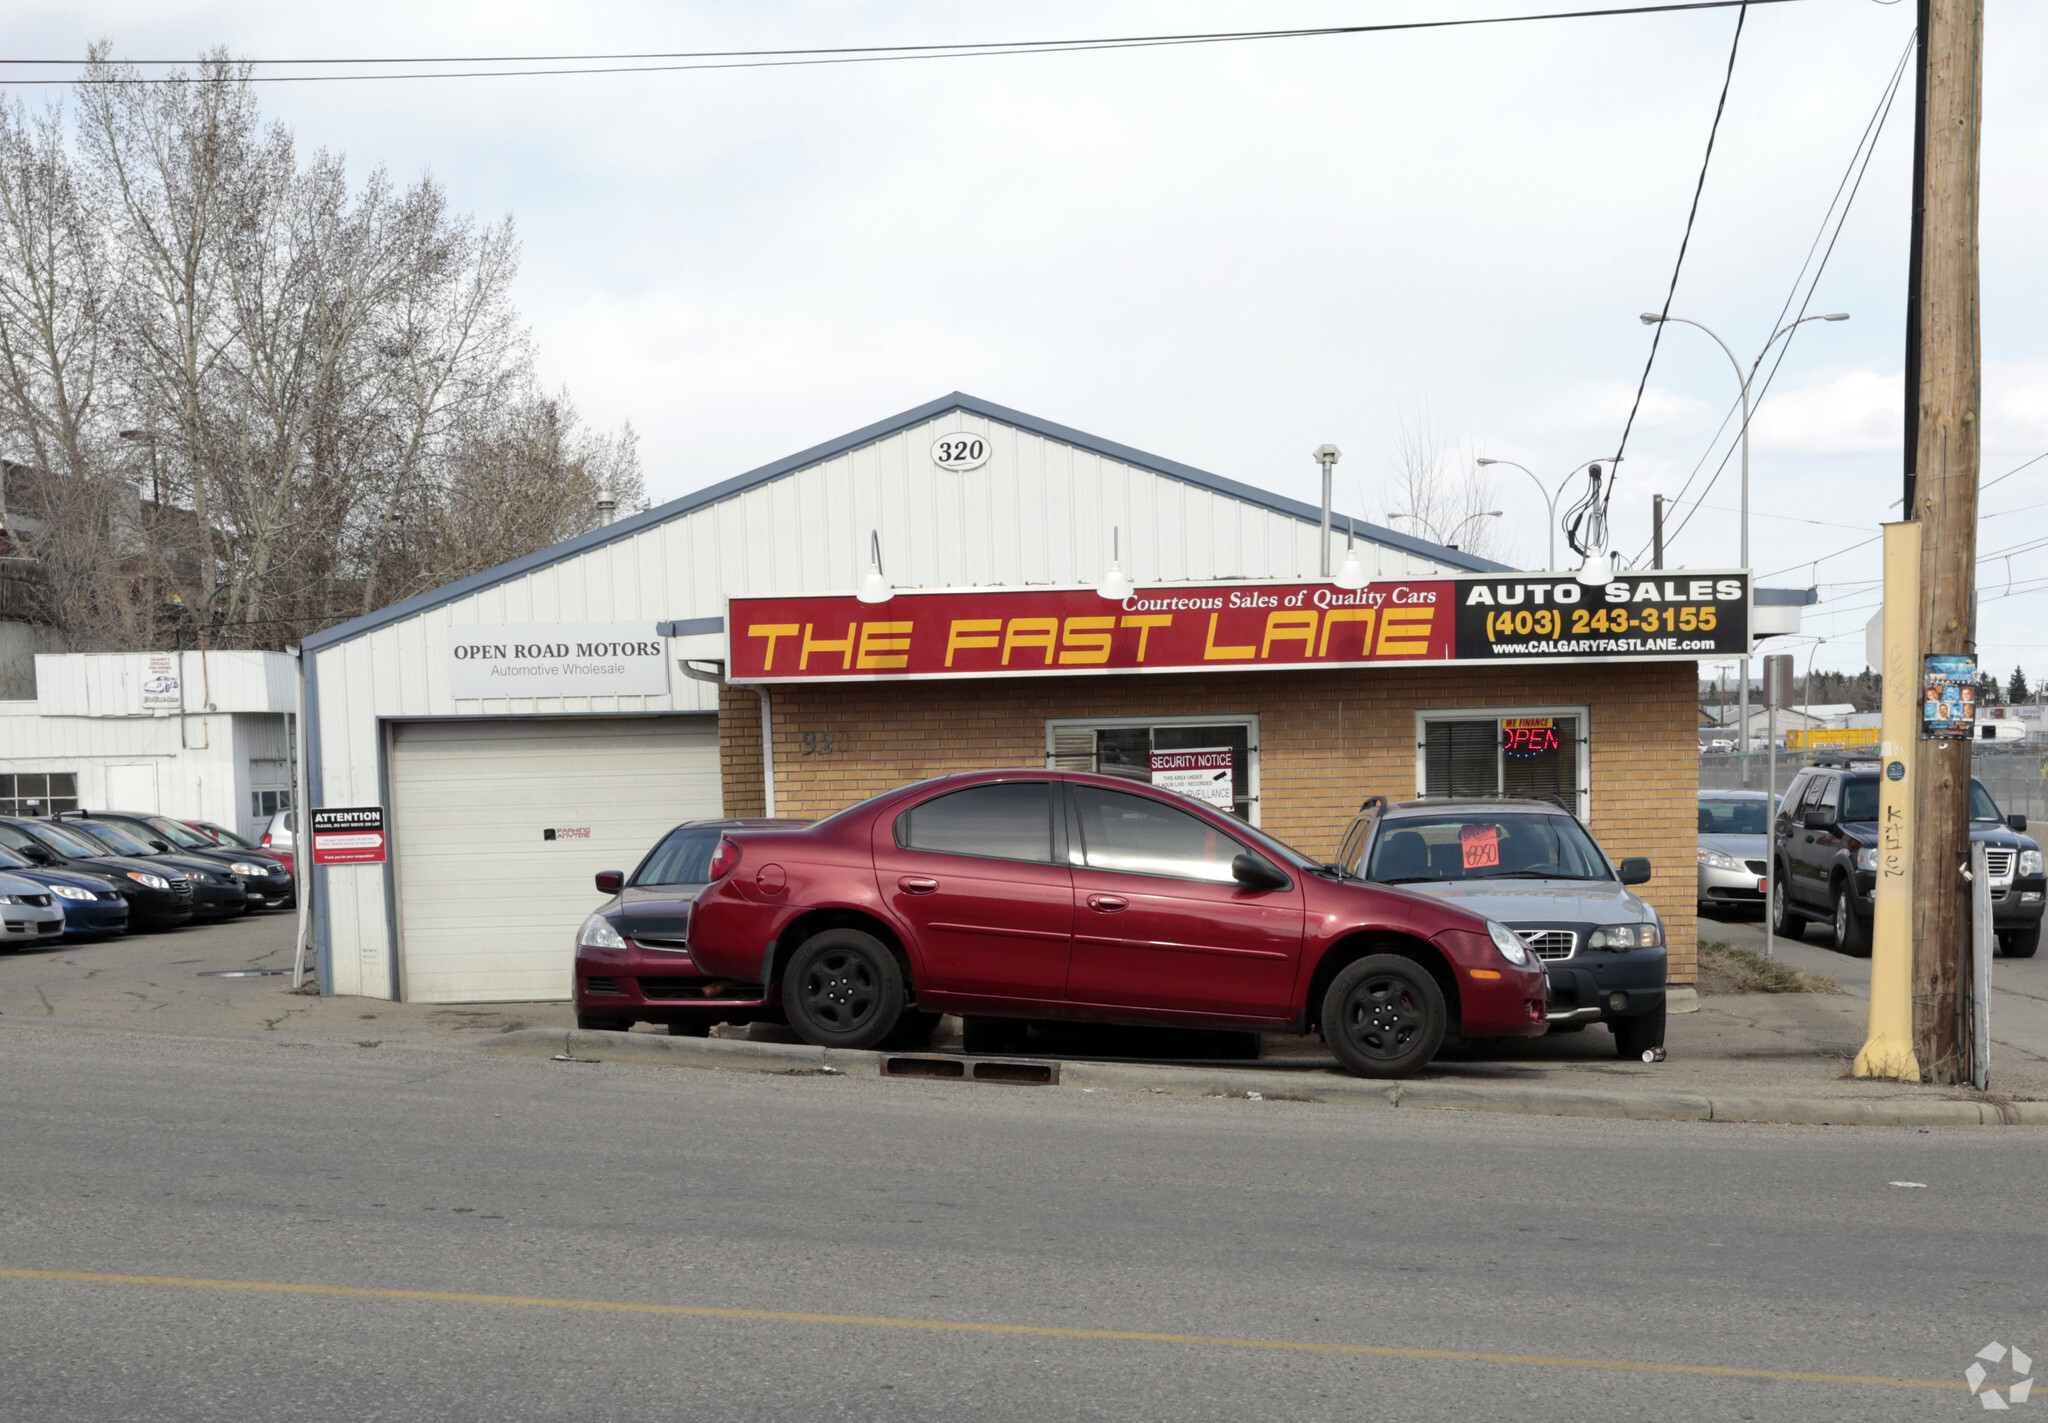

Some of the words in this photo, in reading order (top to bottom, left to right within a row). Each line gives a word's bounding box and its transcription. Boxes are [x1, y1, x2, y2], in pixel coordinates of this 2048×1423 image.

[939, 440, 983, 462] 320
[1122, 594, 1222, 611] Courteous
[1229, 592, 1278, 608] Sales
[1284, 590, 1307, 606] of
[1313, 588, 1386, 609] Quality
[1392, 586, 1436, 604] Cars
[1466, 584, 1580, 605] AUTO
[1605, 580, 1742, 602] SALES
[1486, 610, 1561, 642] (403)
[1572, 606, 1717, 633] 243-3155
[748, 621, 914, 670] THE
[945, 614, 1173, 667] FAST
[1204, 607, 1435, 660] LANE
[1492, 638, 1715, 653] www.CALGARYFASTLANE.com
[454, 645, 507, 660] OPEN
[514, 644, 570, 659] ROAD
[576, 642, 660, 657] MOTORS
[491, 664, 559, 676] Automotive
[562, 662, 625, 675] Wholesale
[1506, 719, 1516, 727] WE
[1519, 718, 1549, 727] FINANCE
[1152, 755, 1196, 768] SECURITY
[1198, 754, 1232, 767] NOTICE
[315, 812, 380, 822] ATTENTION
